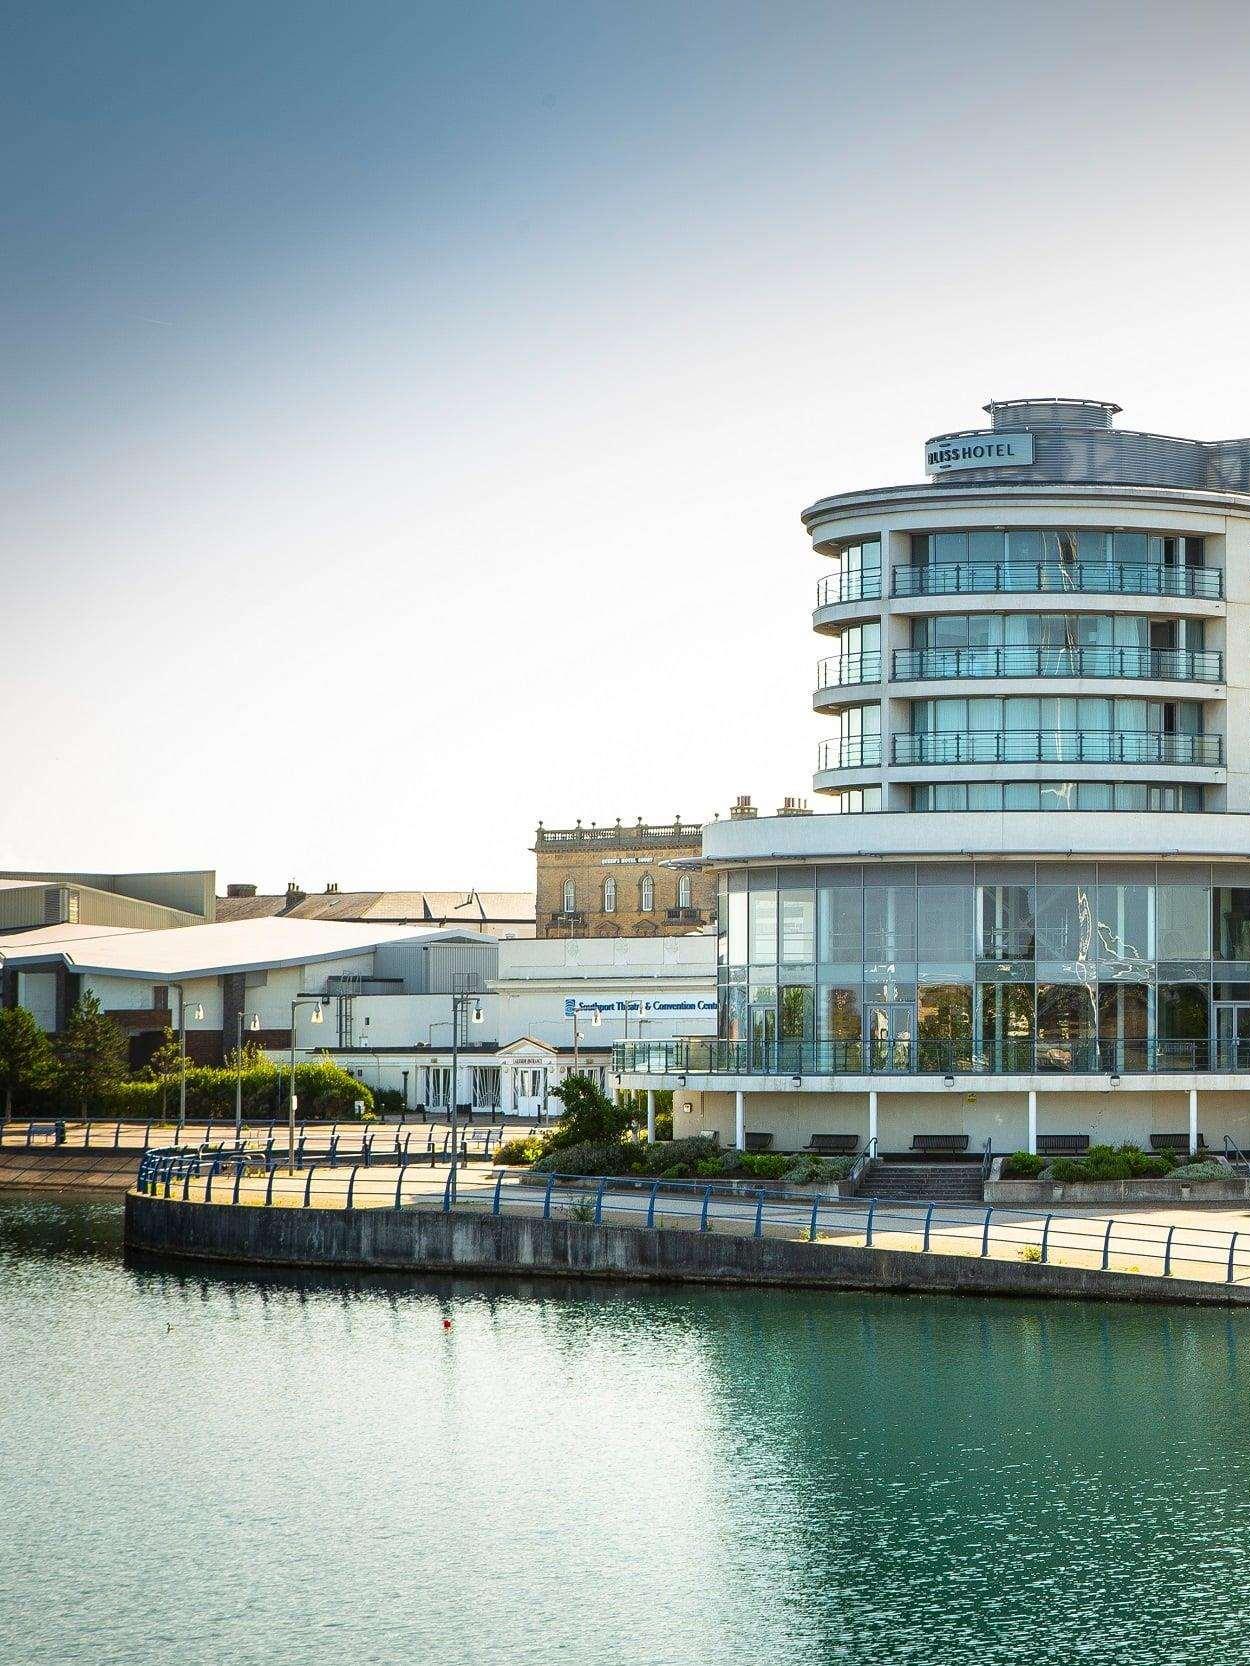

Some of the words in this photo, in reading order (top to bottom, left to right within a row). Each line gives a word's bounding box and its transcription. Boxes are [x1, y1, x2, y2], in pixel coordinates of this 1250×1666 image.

[962, 444, 1015, 459] HOTEL
[578, 1002, 615, 1012] Southport
[645, 1002, 652, 1010] &
[652, 1001, 696, 1010] Convention
